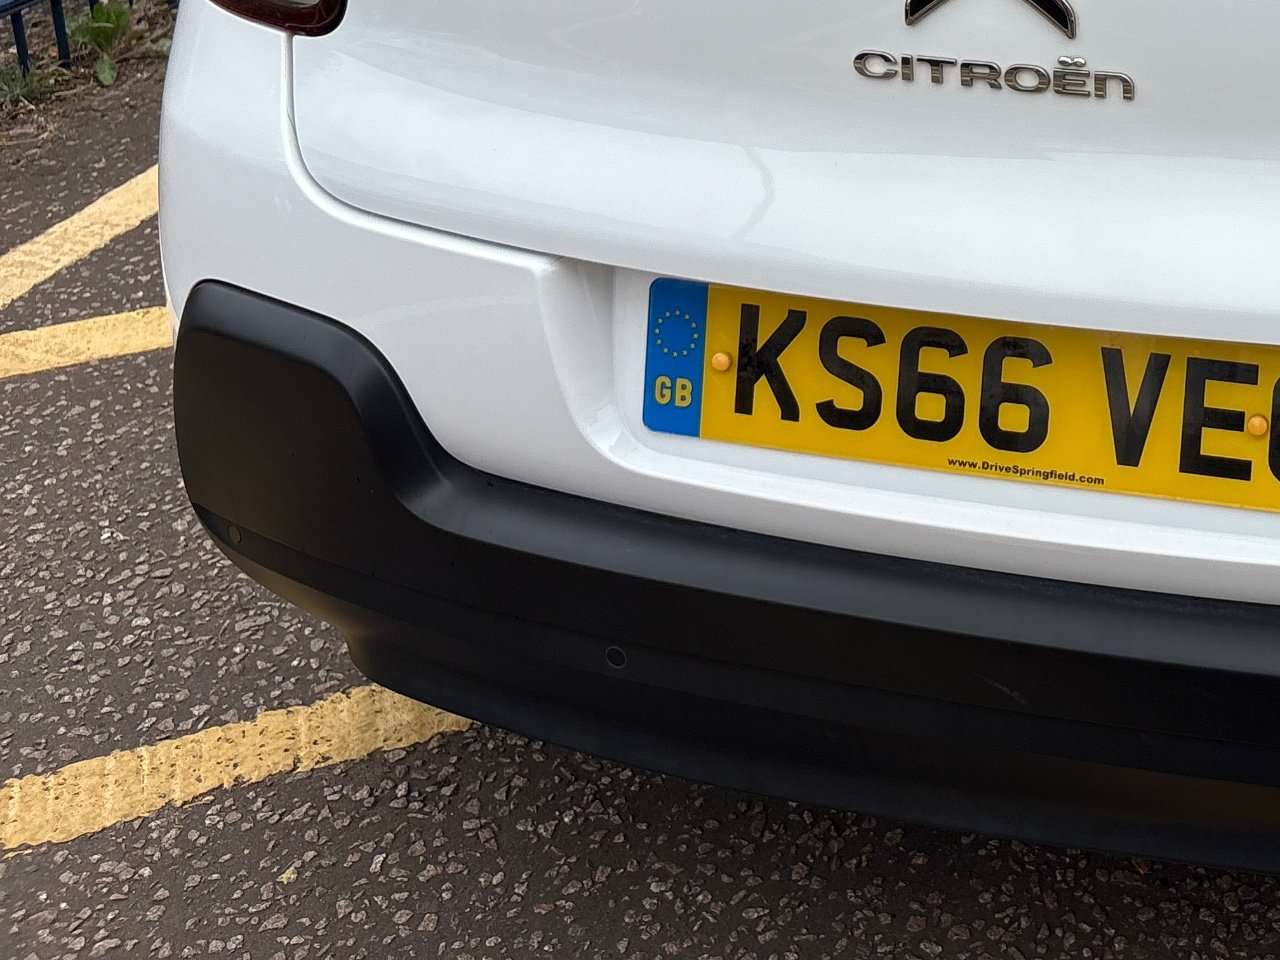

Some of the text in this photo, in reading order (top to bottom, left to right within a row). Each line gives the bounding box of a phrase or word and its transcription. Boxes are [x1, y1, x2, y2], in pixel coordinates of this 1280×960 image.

[655, 375, 693, 409] GB
[734, 303, 1053, 454] KS66
[947, 457, 1105, 486] www.DriveSpringfield.com
